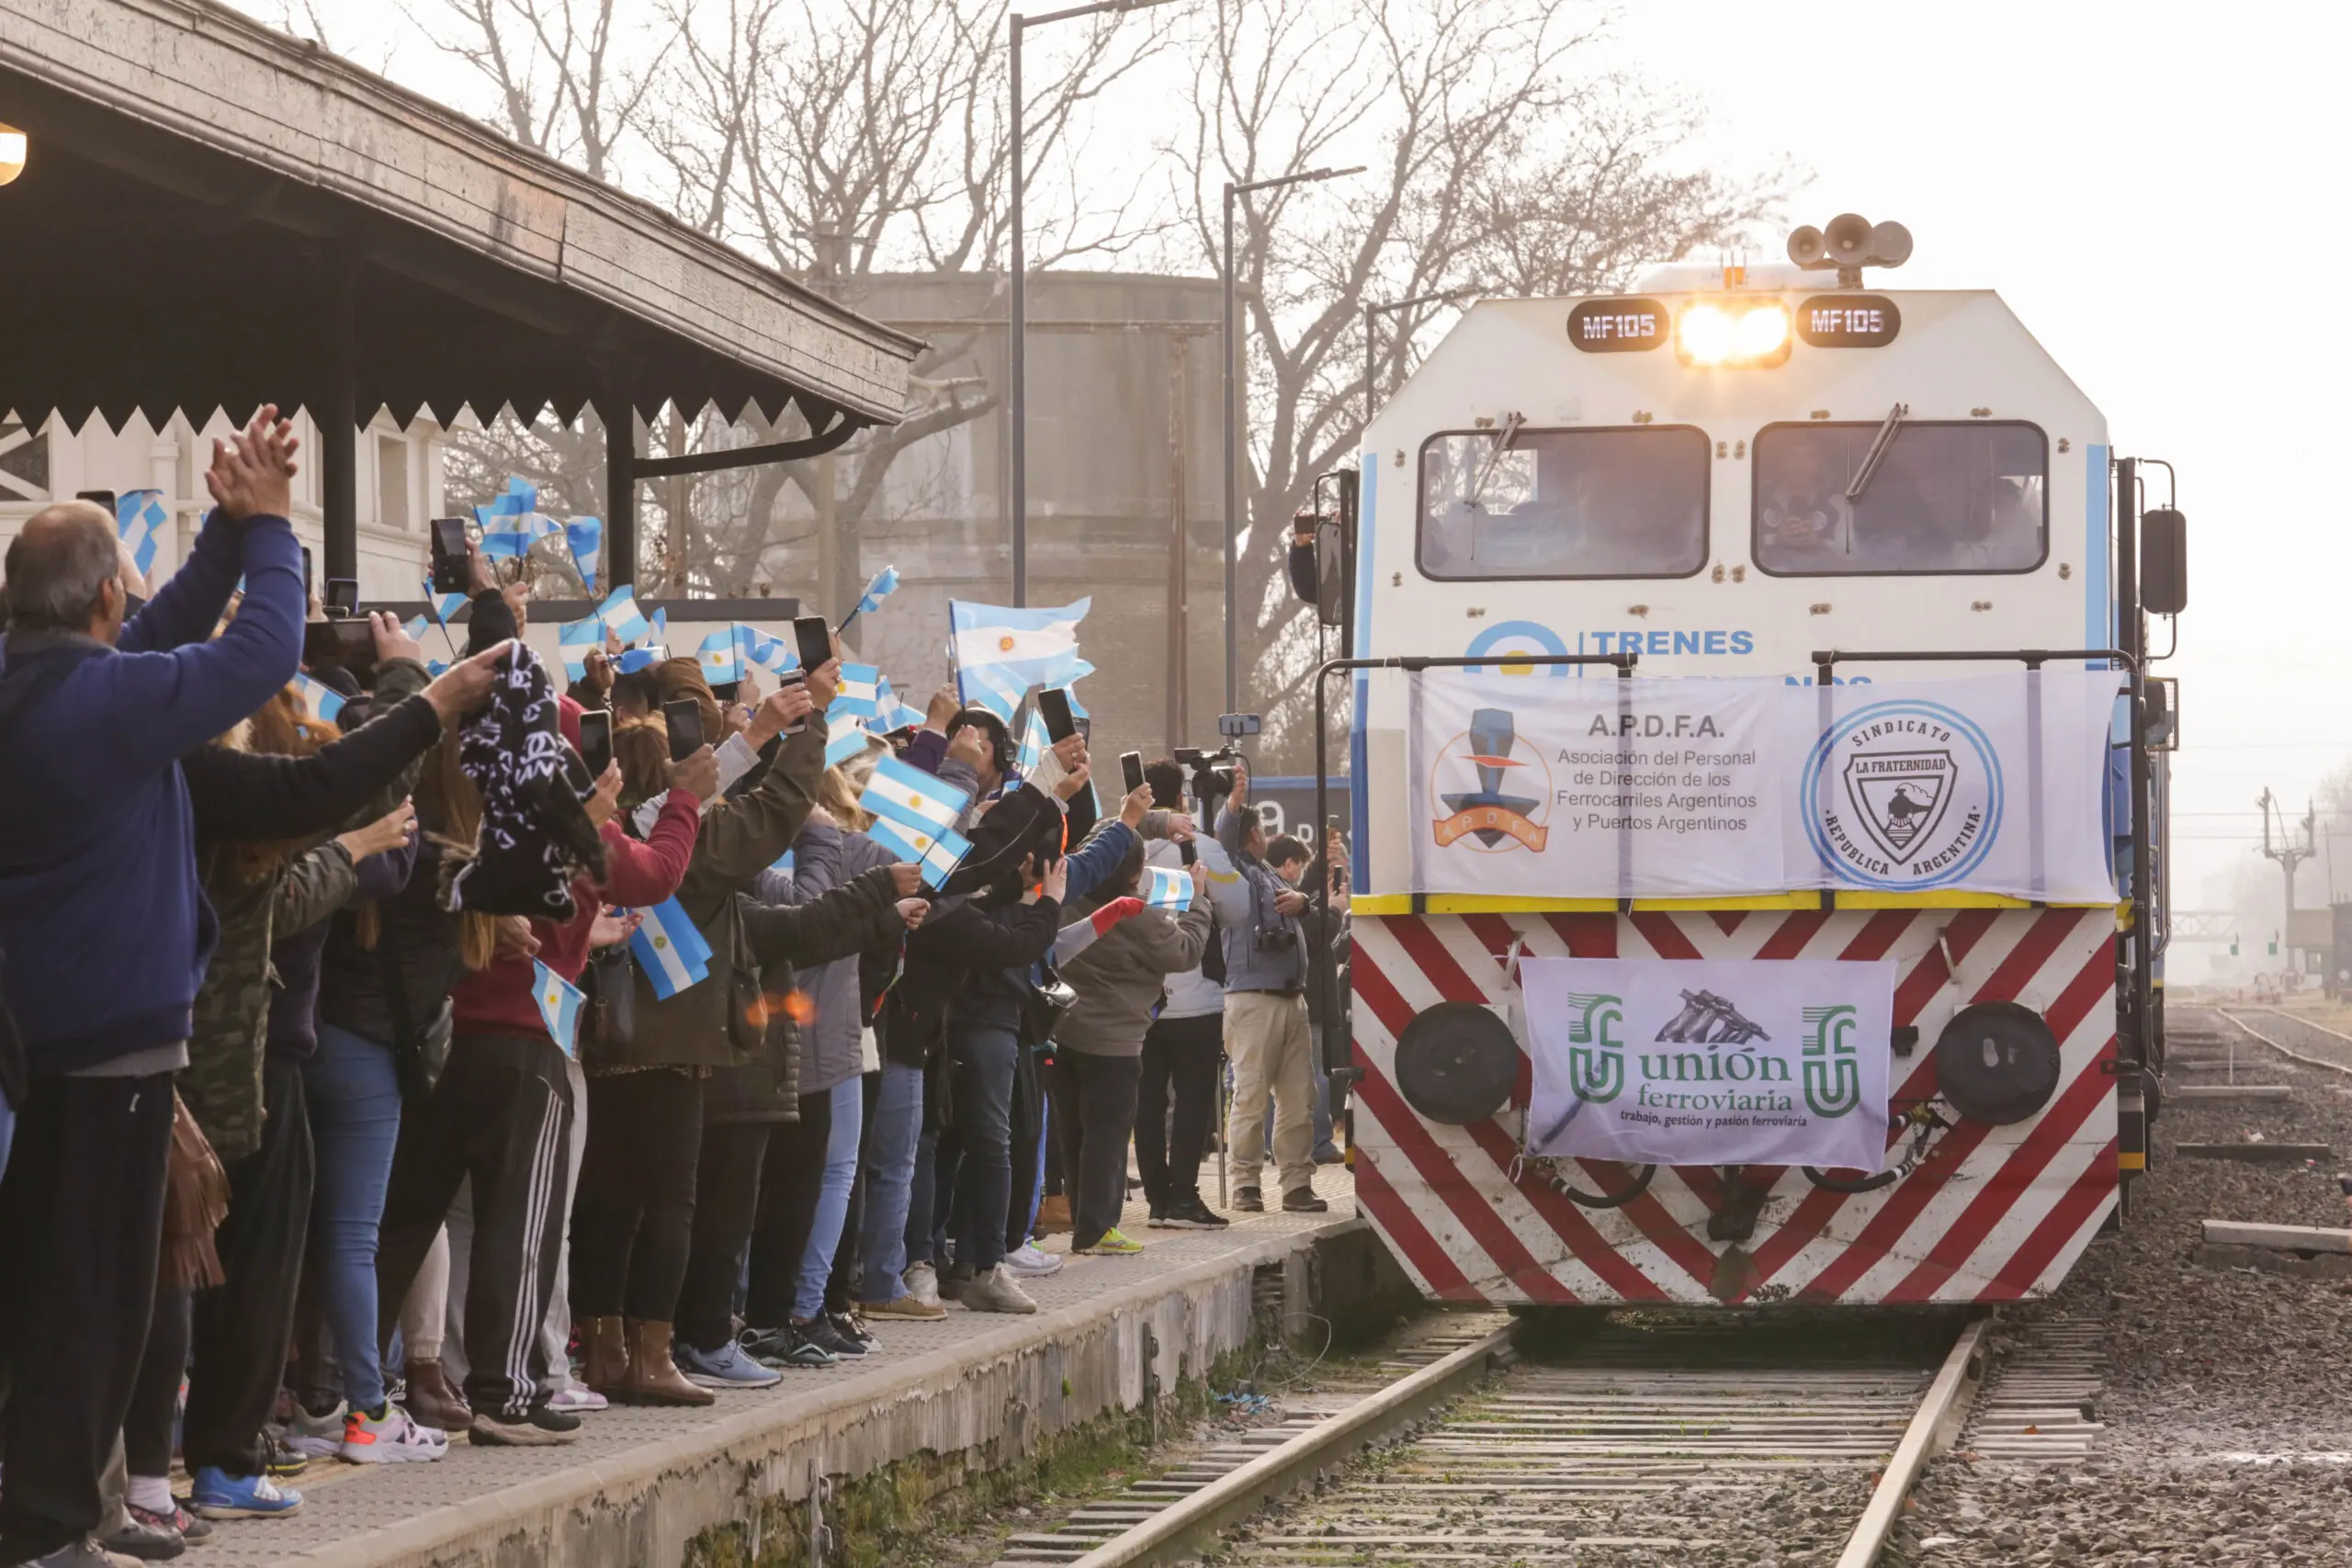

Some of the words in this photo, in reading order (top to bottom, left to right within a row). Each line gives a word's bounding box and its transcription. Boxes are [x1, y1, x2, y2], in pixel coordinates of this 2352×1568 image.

[1583, 314, 1655, 339] MF105
[1811, 310, 1883, 333] MF105
[1590, 630, 1754, 655] TRENES
[1588, 714, 1725, 738] A.P.D.F.A.
[1851, 720, 1951, 747] SINDICATO
[1558, 749, 1648, 765] Asociación
[1654, 750, 1678, 765] del
[1684, 750, 1756, 765] Personal
[1855, 762, 1870, 773] LA
[1871, 758, 1946, 773] FRATERNIDAD
[1573, 770, 1594, 784] de
[1600, 771, 1676, 786] Dirección
[1682, 773, 1702, 786] de
[1708, 772, 1731, 786] los
[1557, 790, 1662, 807] Ferrocarriles
[1668, 793, 1757, 811] Argentinos
[1573, 817, 1582, 831] y
[1588, 814, 1652, 829] Puertos
[1657, 815, 1747, 834] Argentinos
[1825, 815, 1889, 875] REPUBLICA
[1913, 812, 1981, 875] ARGENTINA
[1637, 1044, 1792, 1081] unión
[1637, 1083, 1792, 1111] ferroviaria
[1621, 1111, 1661, 1125] trabajo,
[1664, 1115, 1702, 1128] gestión
[1706, 1117, 1712, 1129] y
[1714, 1114, 1749, 1128] pasión
[1752, 1114, 1807, 1127] ferroviaria
